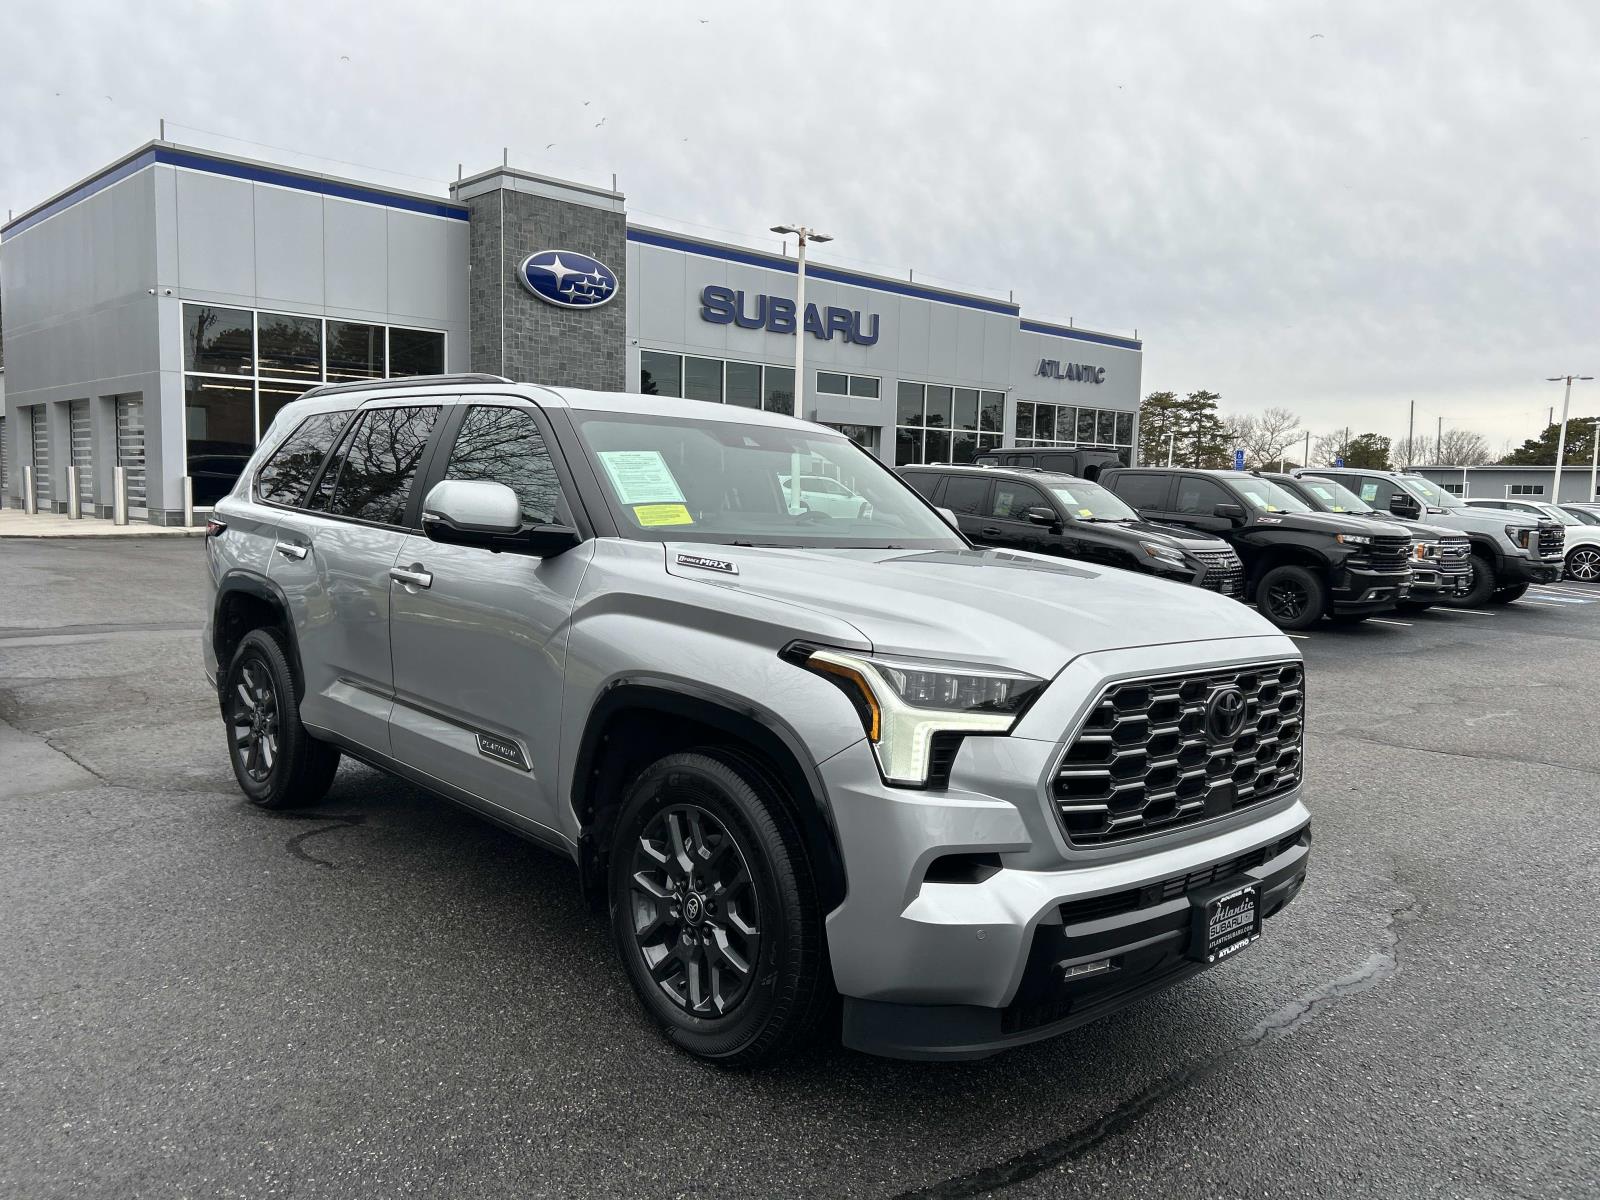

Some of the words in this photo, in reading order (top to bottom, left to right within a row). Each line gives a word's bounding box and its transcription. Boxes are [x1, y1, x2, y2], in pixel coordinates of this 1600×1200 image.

[701, 285, 880, 346] SUBARU
[1034, 358, 1106, 384] ATLANTIC
[700, 558, 728, 569] MAX
[482, 739, 516, 757] PLATINUM
[1209, 897, 1255, 926] Atlantic
[1210, 914, 1243, 938] SUBARU
